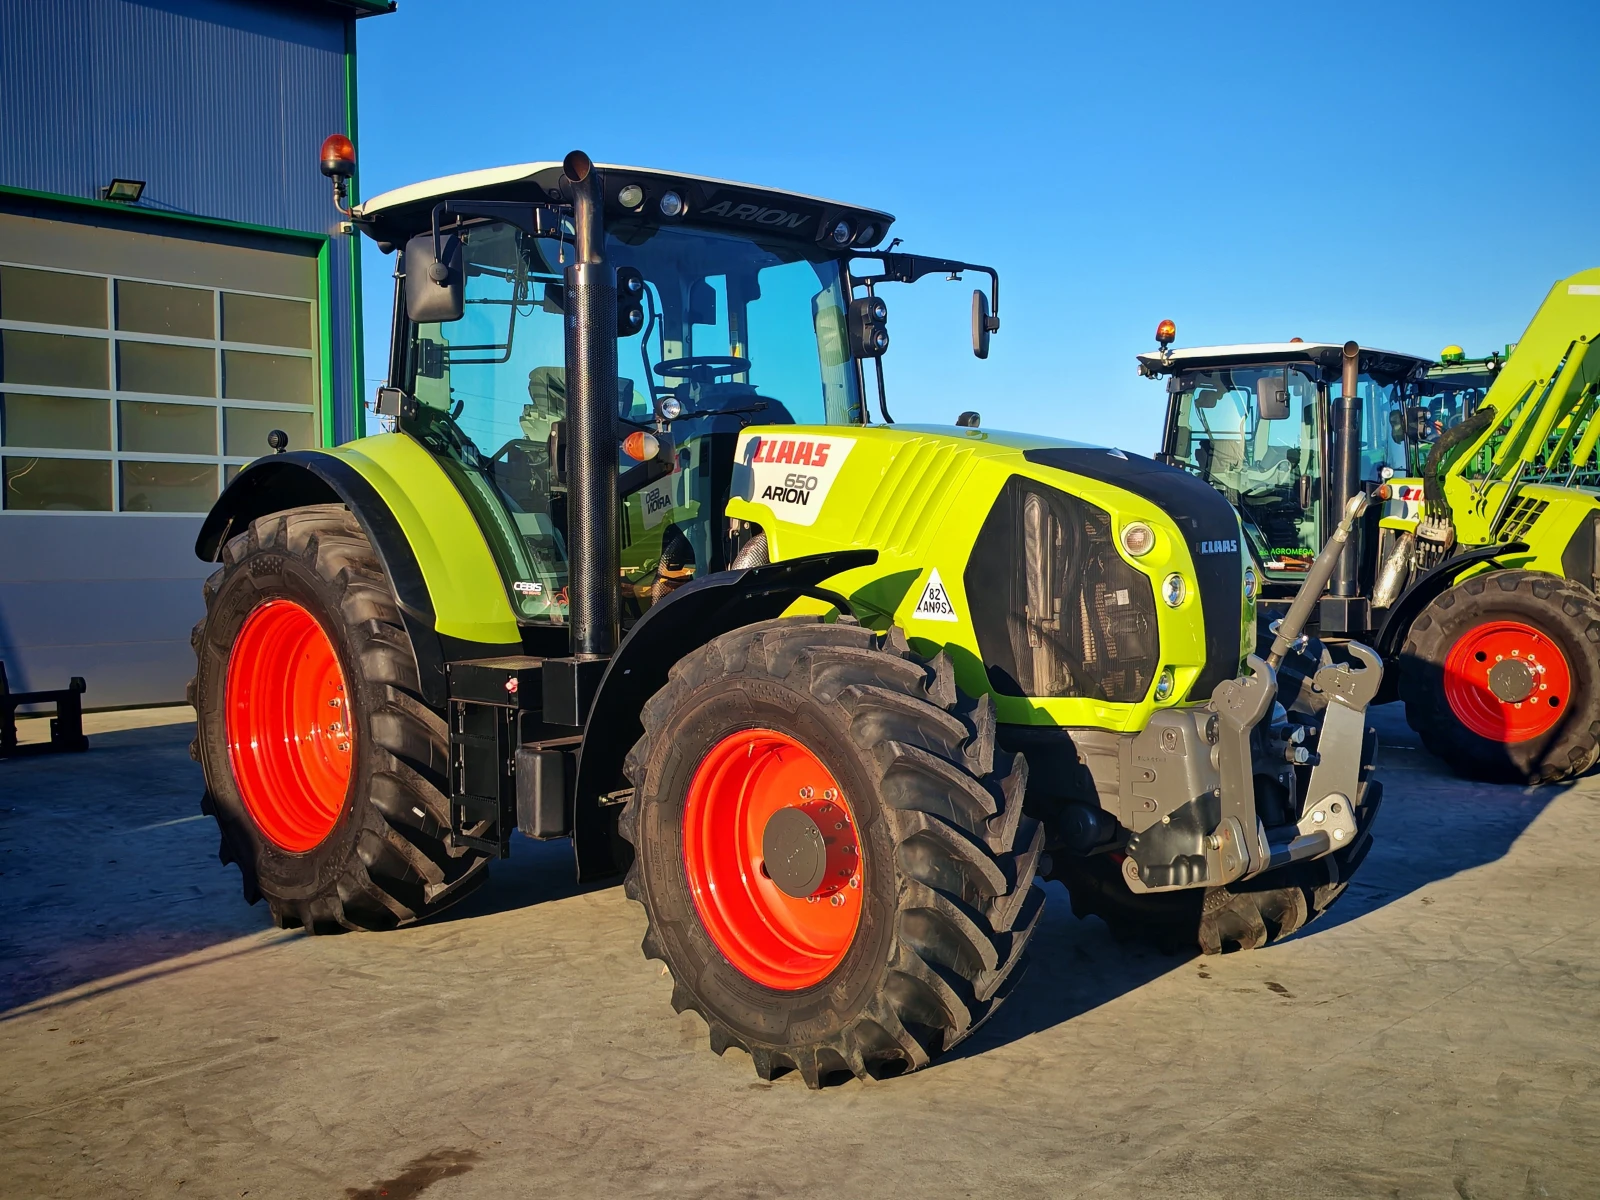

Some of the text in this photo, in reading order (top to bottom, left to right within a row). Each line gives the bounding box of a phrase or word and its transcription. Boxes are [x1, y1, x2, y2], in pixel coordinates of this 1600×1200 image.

[700, 201, 812, 228] ARION
[753, 440, 831, 468] CLAAS
[784, 473, 818, 491] 650
[762, 485, 810, 506] ARION
[1201, 540, 1238, 554] CLAAS
[1270, 547, 1314, 556] AGROMEGA
[929, 588, 941, 600] 82
[923, 601, 947, 614] AN9S
